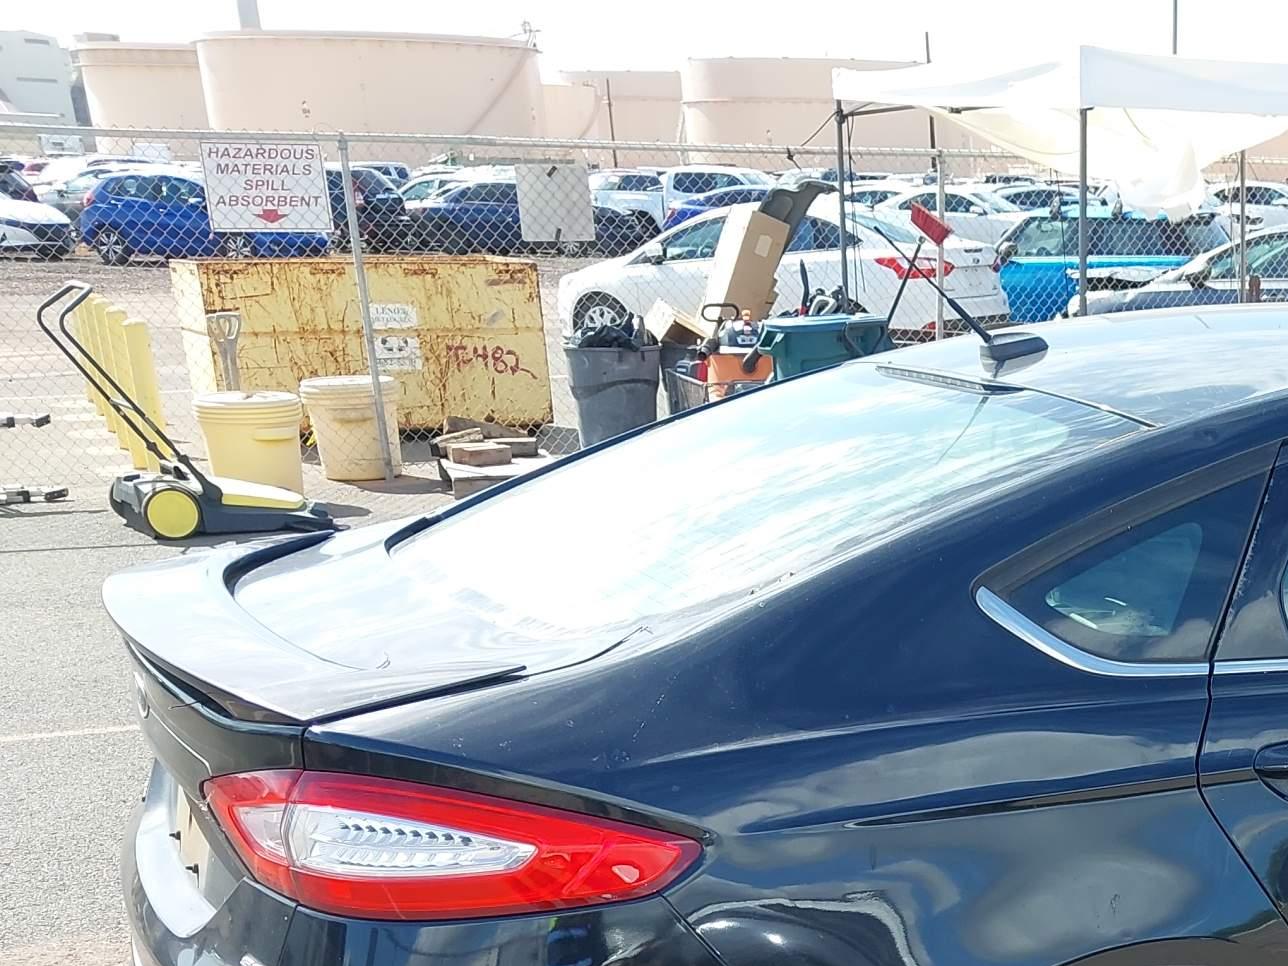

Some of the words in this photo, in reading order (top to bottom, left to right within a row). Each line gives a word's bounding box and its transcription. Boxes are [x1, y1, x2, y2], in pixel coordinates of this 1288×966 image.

[207, 146, 315, 160] HAZARDOUS
[216, 163, 313, 176] MATERIALS
[243, 179, 291, 191] SPILL
[215, 194, 321, 207] ABSORBENT
